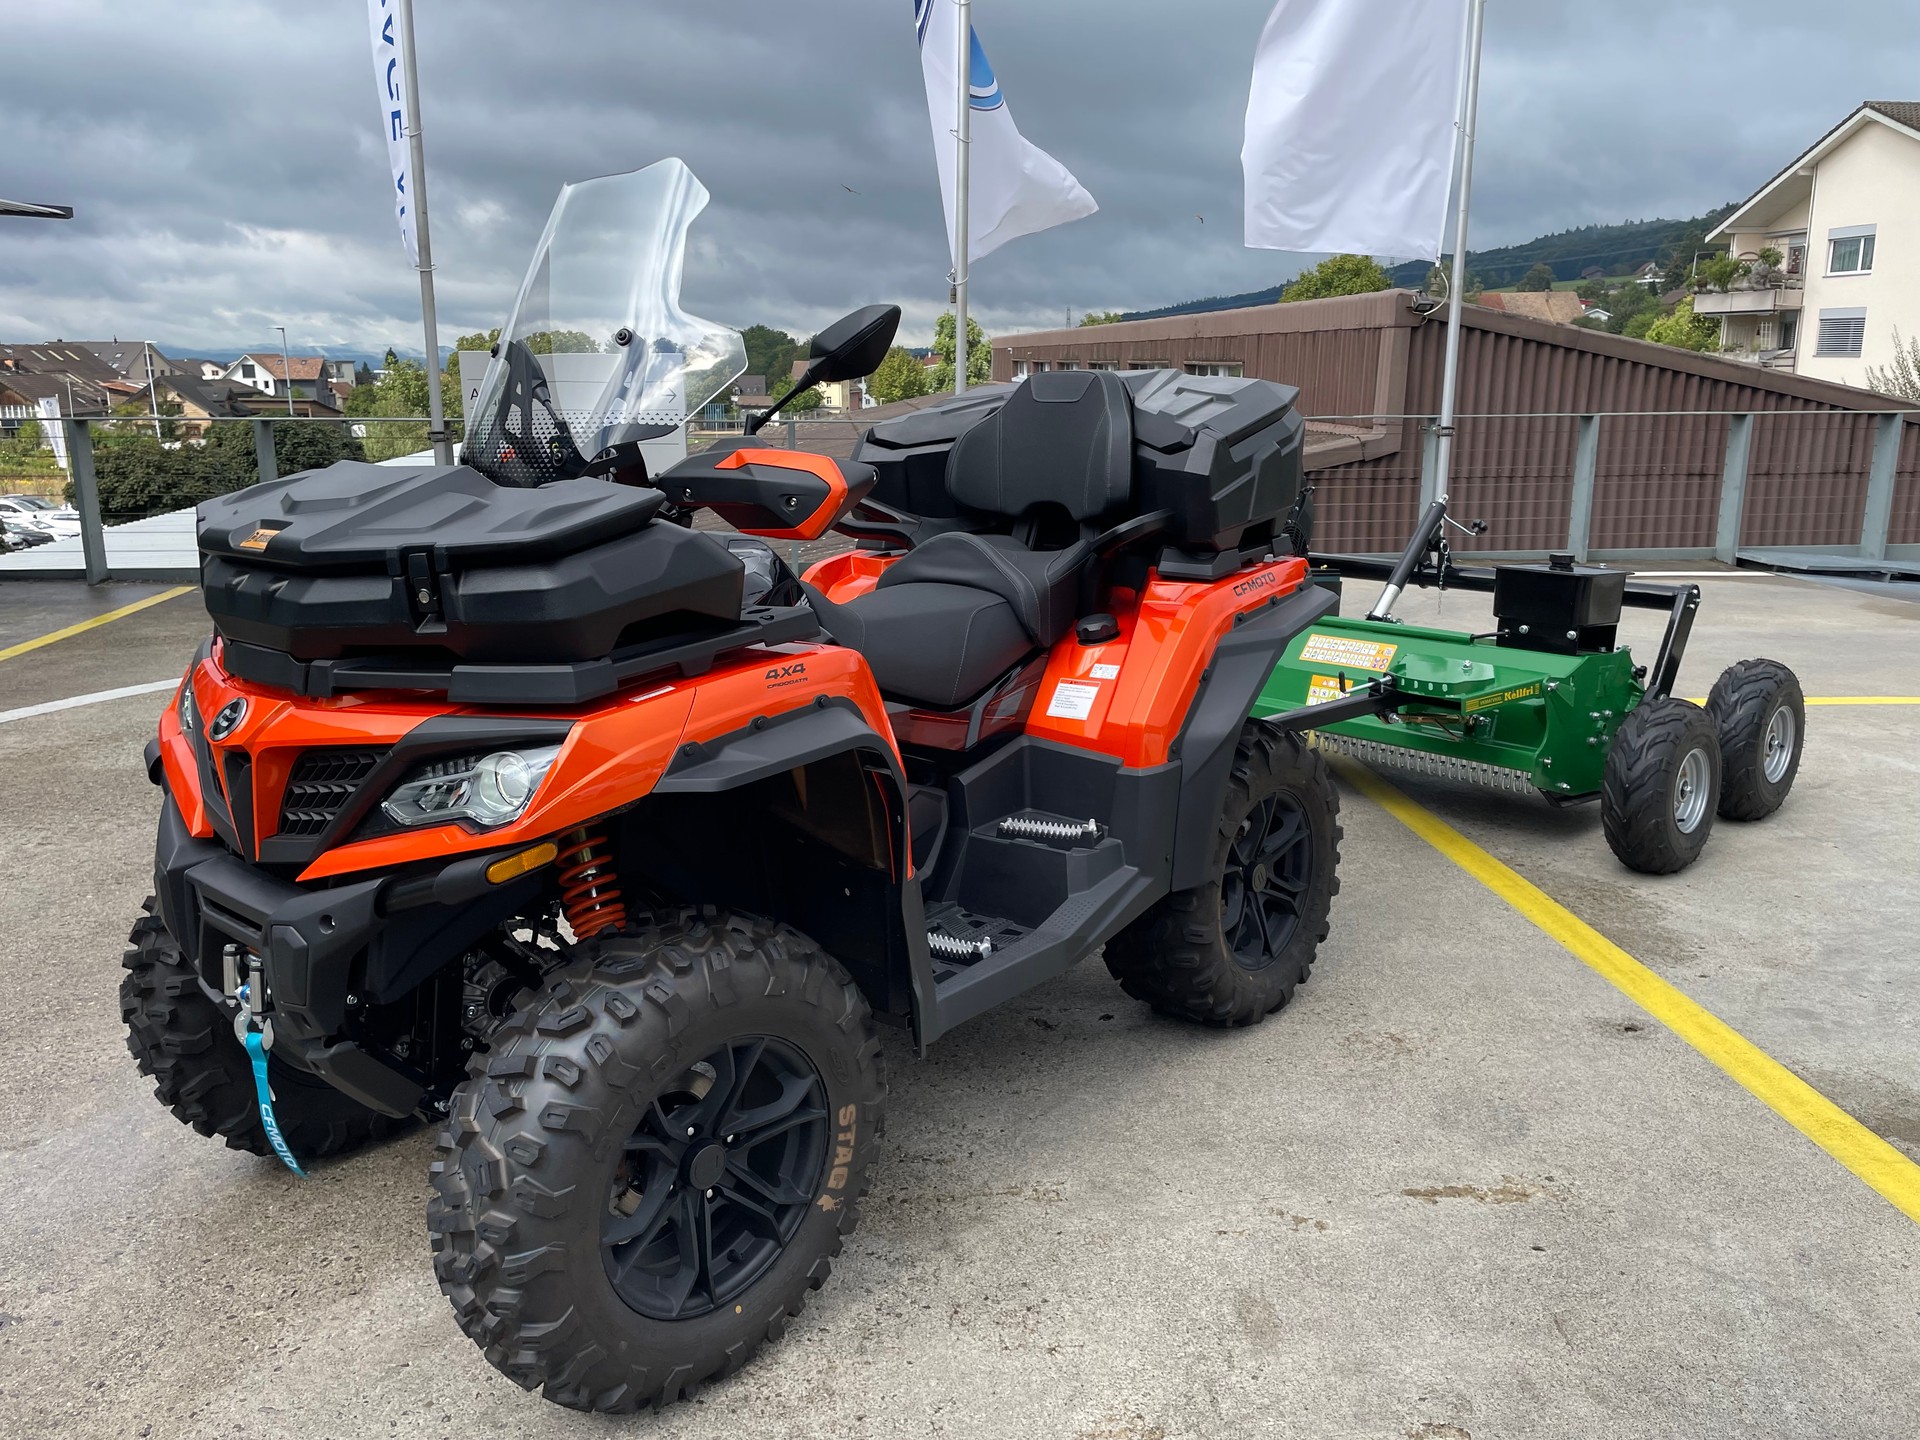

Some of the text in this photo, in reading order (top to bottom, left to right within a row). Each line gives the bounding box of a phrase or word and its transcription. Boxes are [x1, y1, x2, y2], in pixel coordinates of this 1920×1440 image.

[1233, 571, 1276, 597] CFMOTO
[1504, 685, 1535, 702] Kellfri
[261, 1103, 298, 1169] CFMOTO
